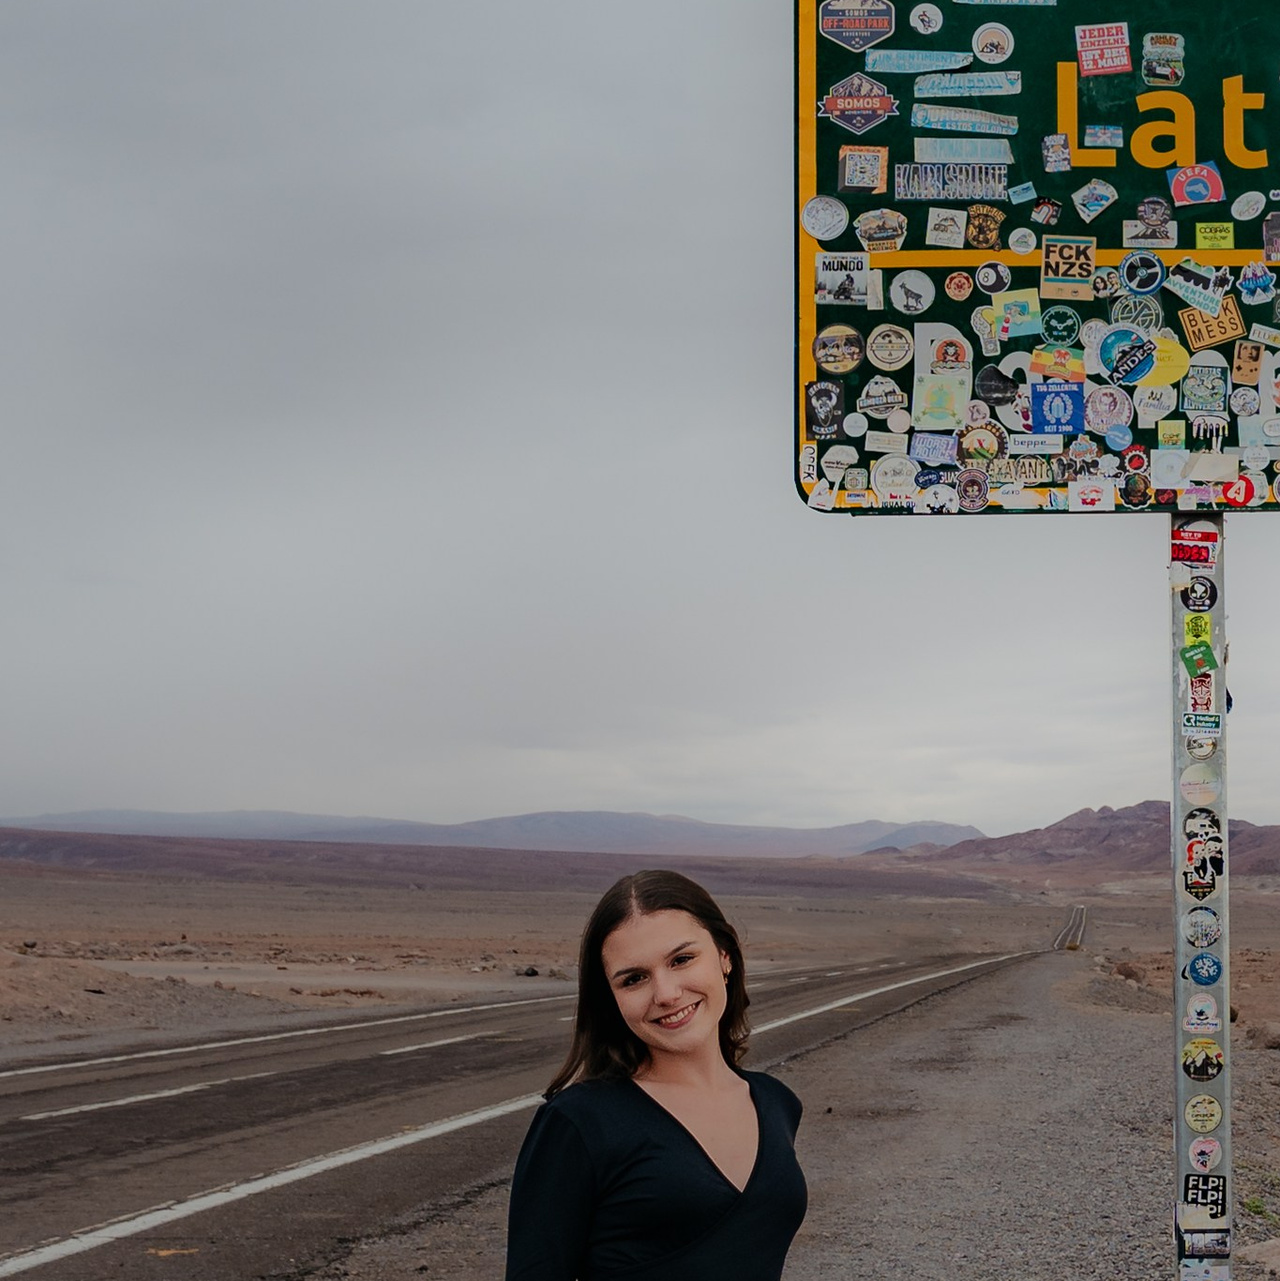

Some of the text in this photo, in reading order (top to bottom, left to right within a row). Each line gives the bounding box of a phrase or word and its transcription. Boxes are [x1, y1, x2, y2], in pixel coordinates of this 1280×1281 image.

[1080, 26, 1124, 40] JEDER
[836, 98, 880, 109] SOMOS
[1177, 167, 1209, 182] UEFA
[1044, 244, 1092, 261] FCK
[822, 260, 864, 272] MUNDO
[1044, 261, 1092, 278] NZS
[1189, 301, 1234, 329] BLK
[1191, 317, 1240, 345] MESS
[1112, 341, 1155, 381] ANDES
[915, 435, 953, 448] WORST
[1013, 437, 1047, 448] beppe
[1188, 1176, 1223, 1190] FLP!
[1187, 1189, 1223, 1204] FLP!
